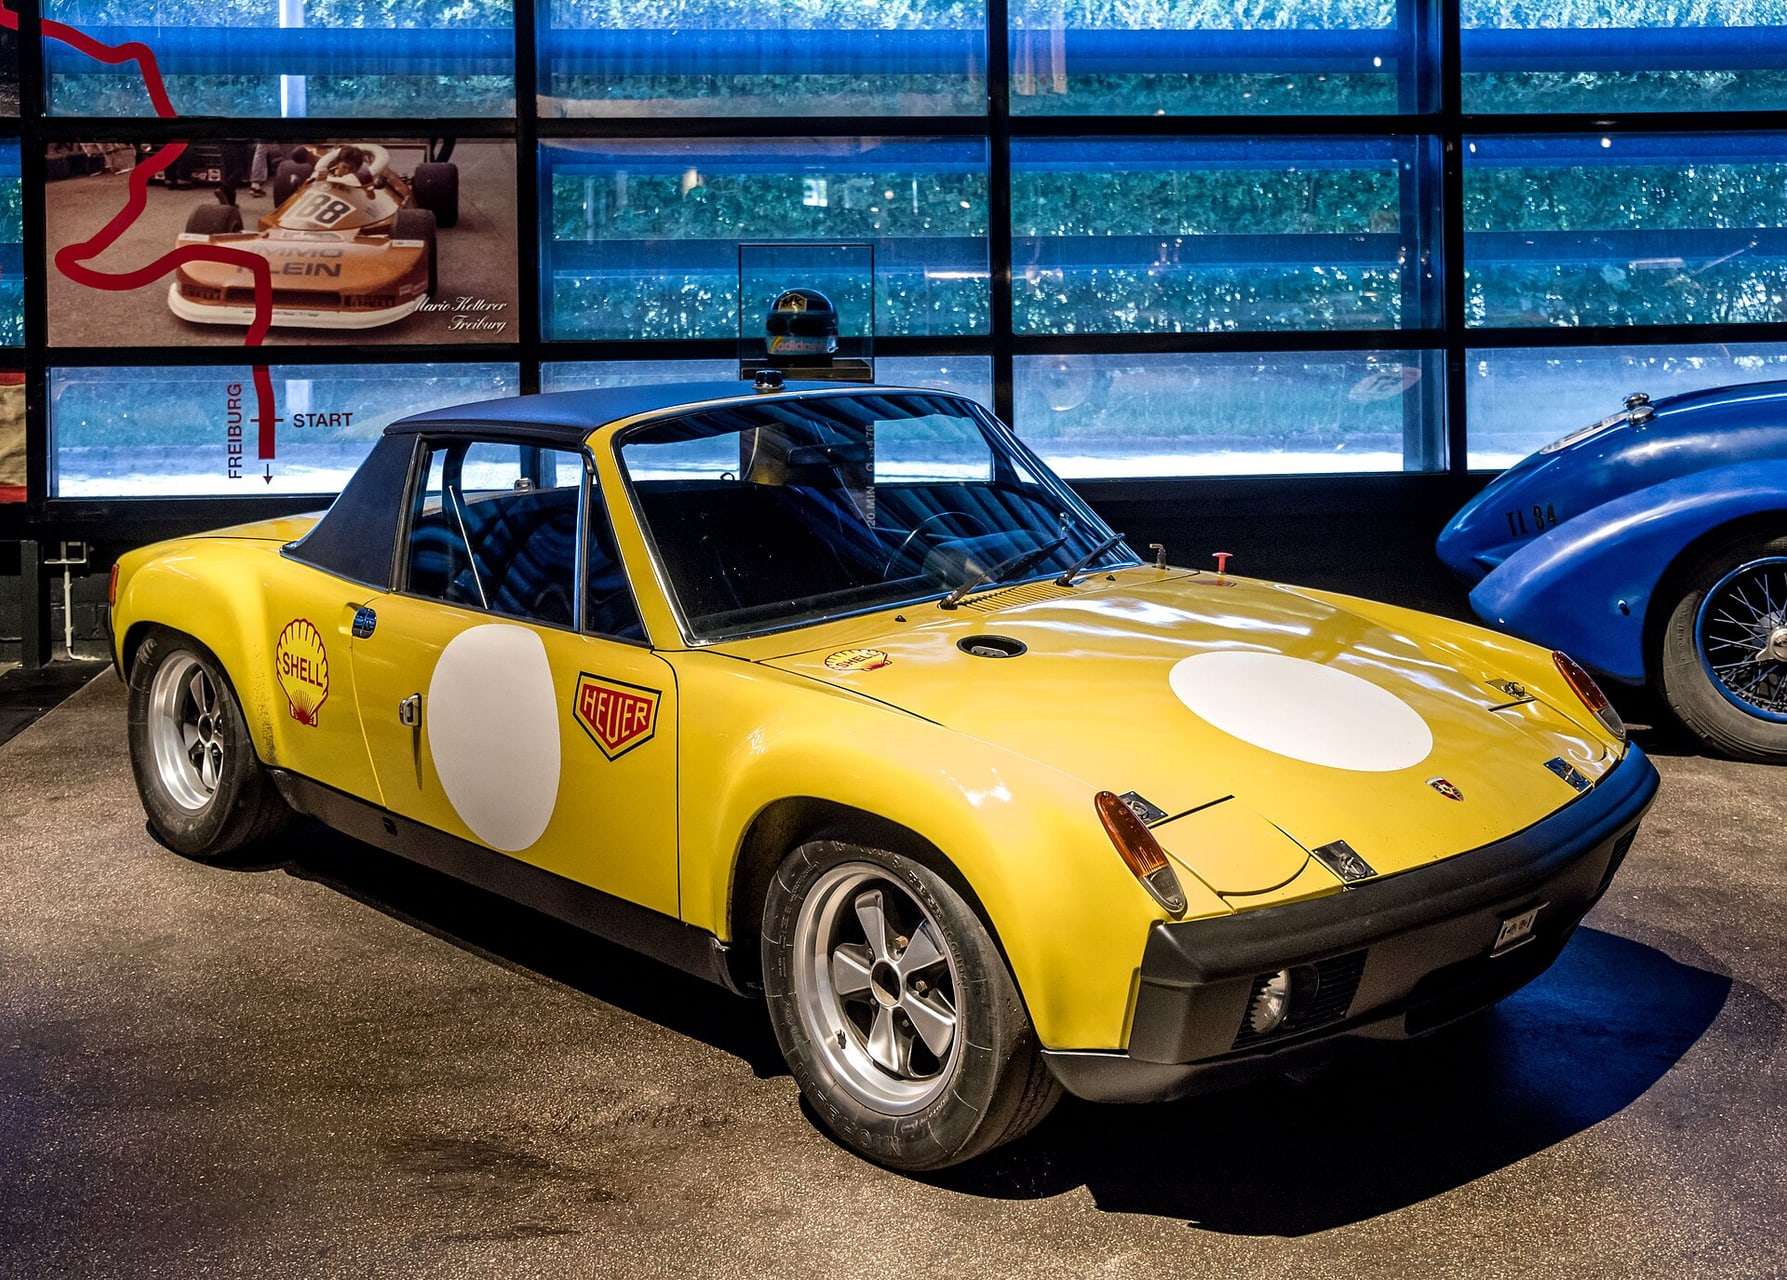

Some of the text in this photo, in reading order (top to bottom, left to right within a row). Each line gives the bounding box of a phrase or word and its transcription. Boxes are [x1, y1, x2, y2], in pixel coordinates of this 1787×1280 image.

[448, 314, 507, 334] Freiburg
[227, 383, 242, 479] FREIBURG
[293, 412, 353, 428] START
[282, 651, 324, 689] SHELL
[583, 687, 650, 744] HEUER
